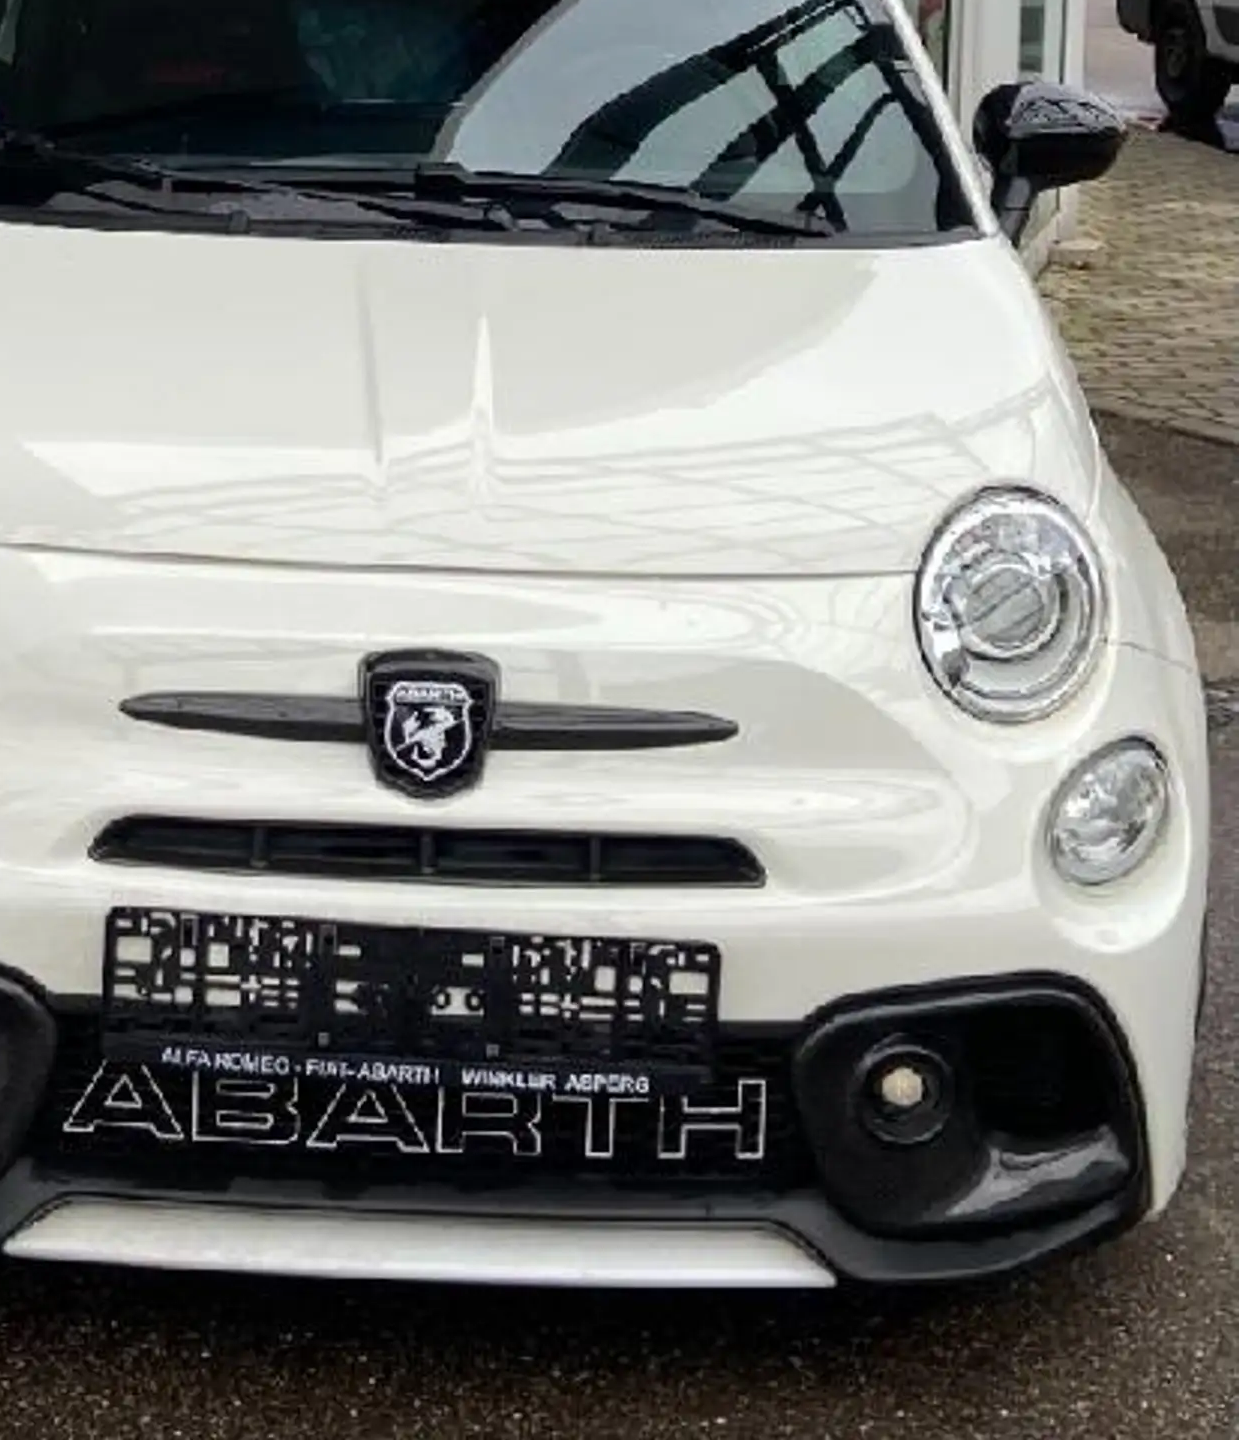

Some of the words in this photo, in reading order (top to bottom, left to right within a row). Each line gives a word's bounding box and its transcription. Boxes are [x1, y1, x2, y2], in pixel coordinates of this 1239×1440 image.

[162, 1046, 211, 1068] ALFA
[213, 1052, 291, 1076] ROMEO
[63, 1058, 767, 1160] ABARTH
